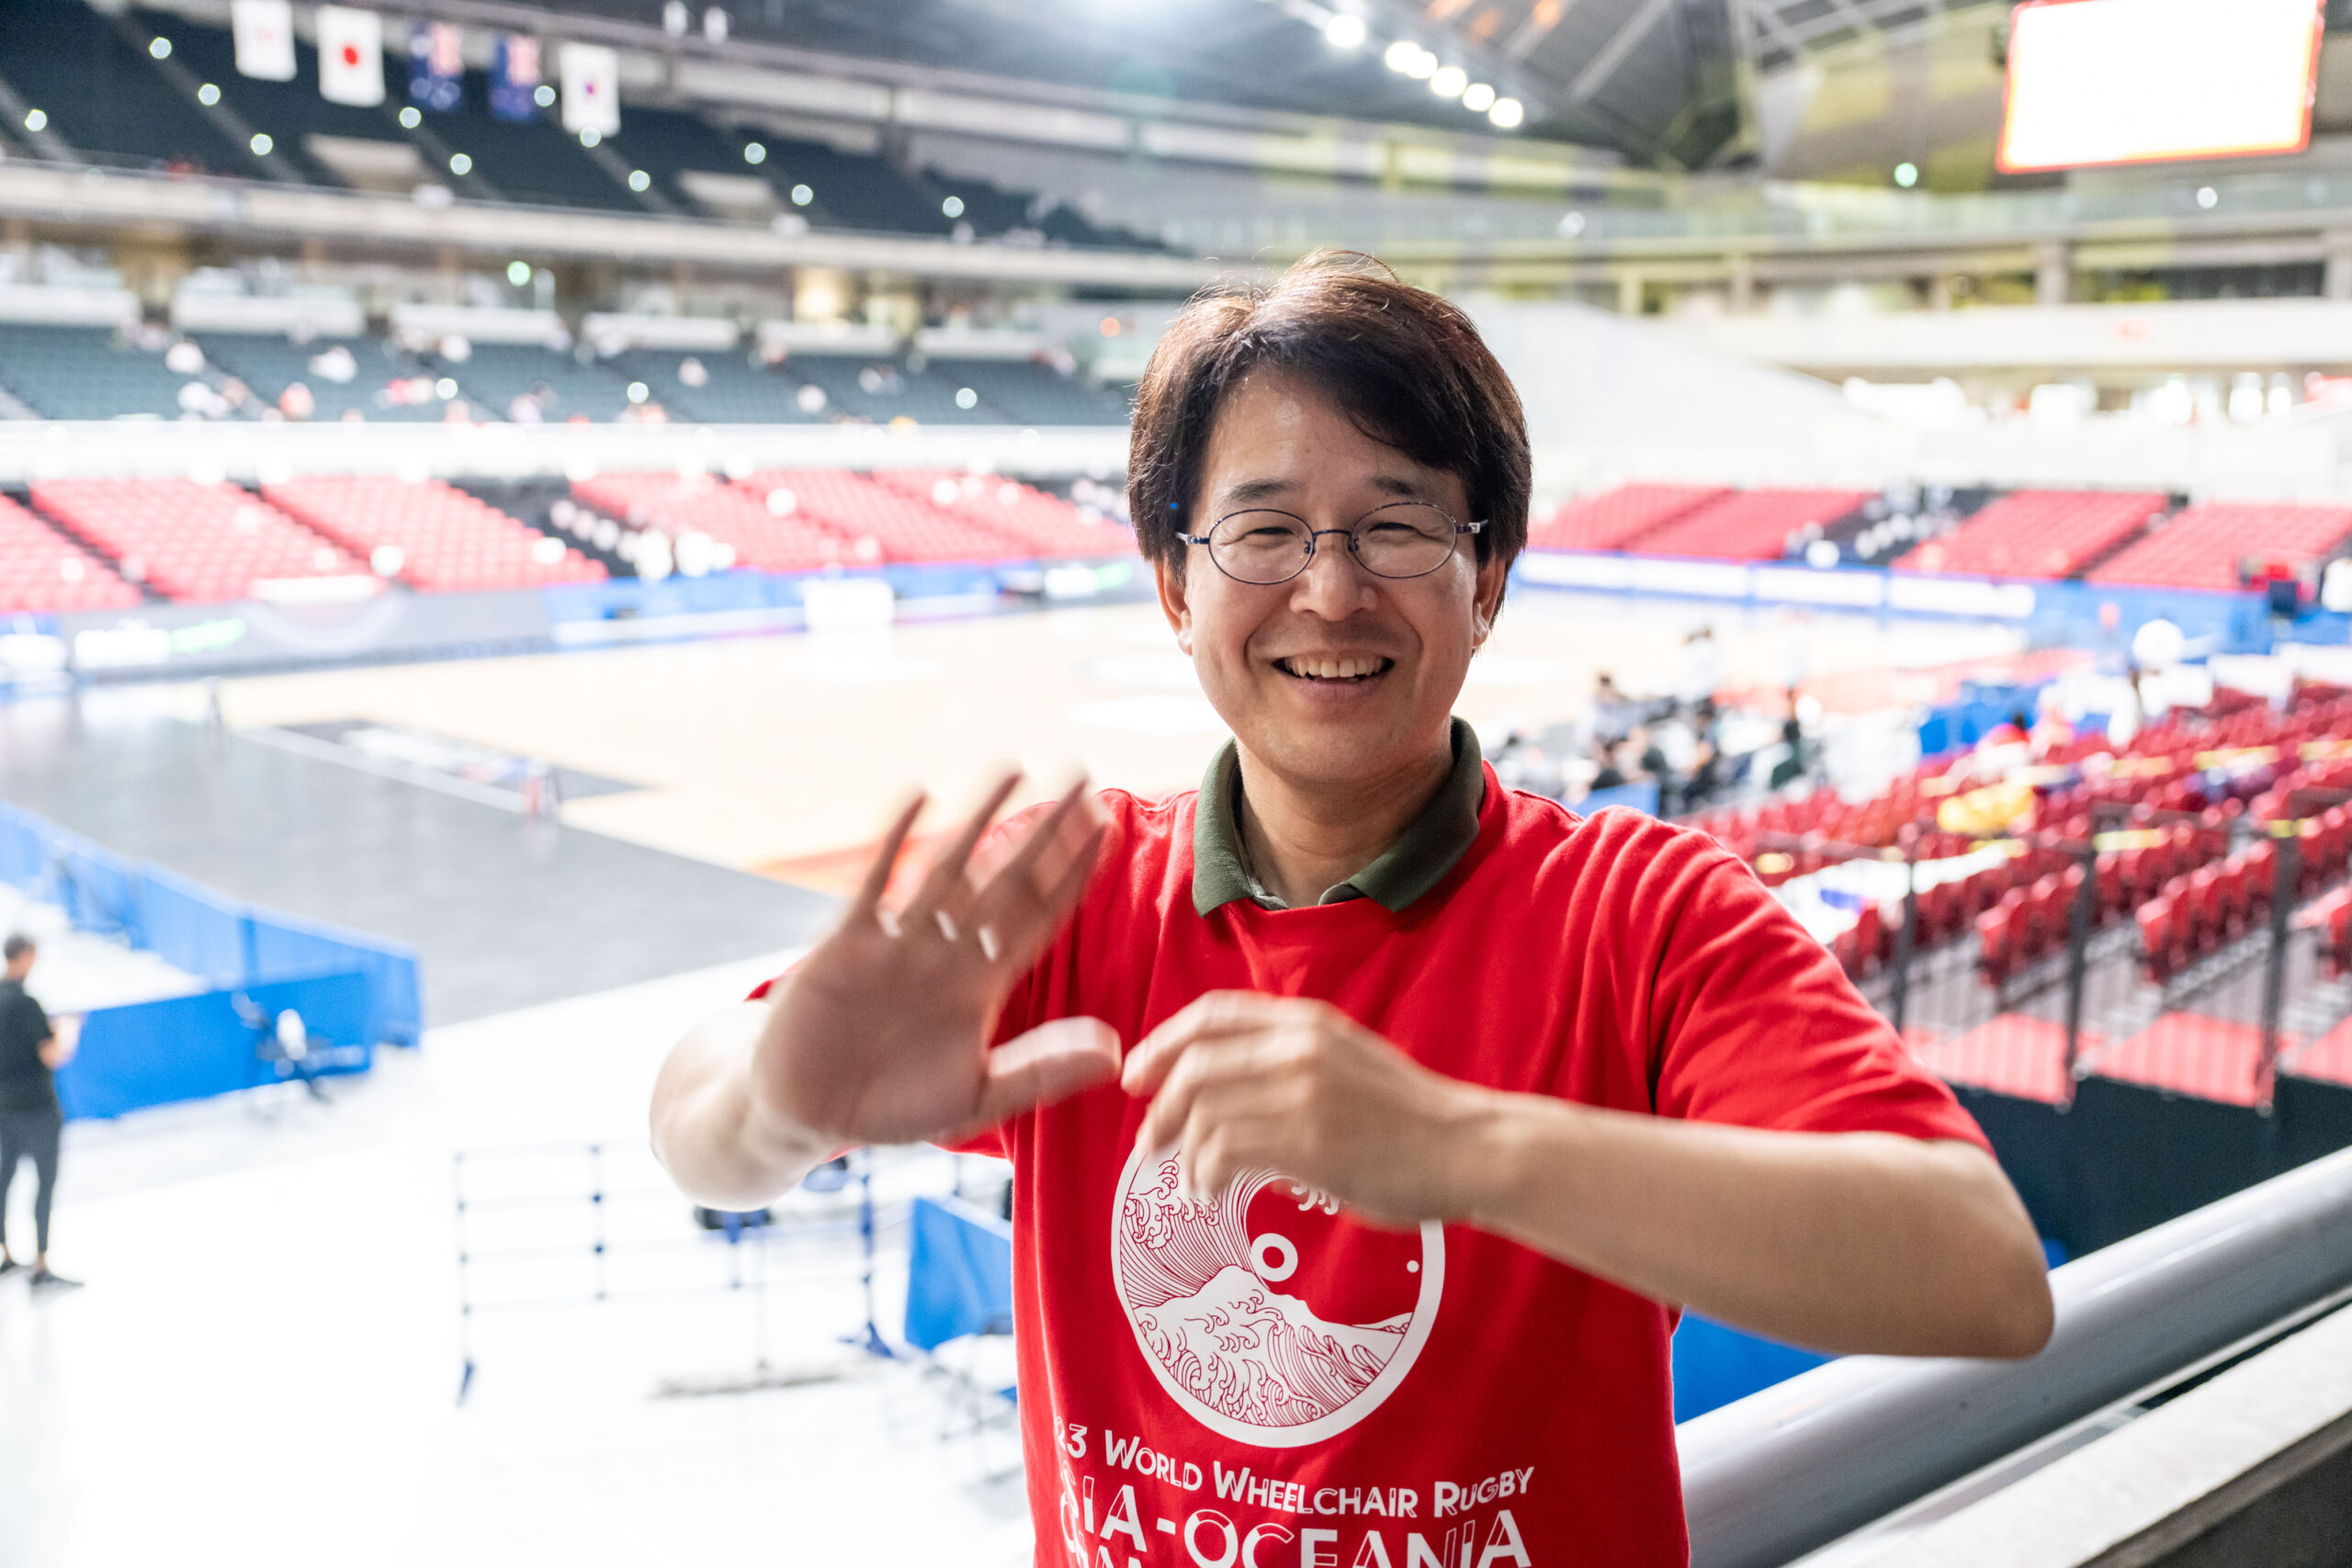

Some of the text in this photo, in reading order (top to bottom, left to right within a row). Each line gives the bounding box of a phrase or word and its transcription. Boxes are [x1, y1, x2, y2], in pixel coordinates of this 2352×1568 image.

[1104, 1429, 1203, 1492] WORLD
[1213, 1461, 1418, 1518] WHEELCHAIR
[1433, 1466, 1535, 1518] RUGBY
